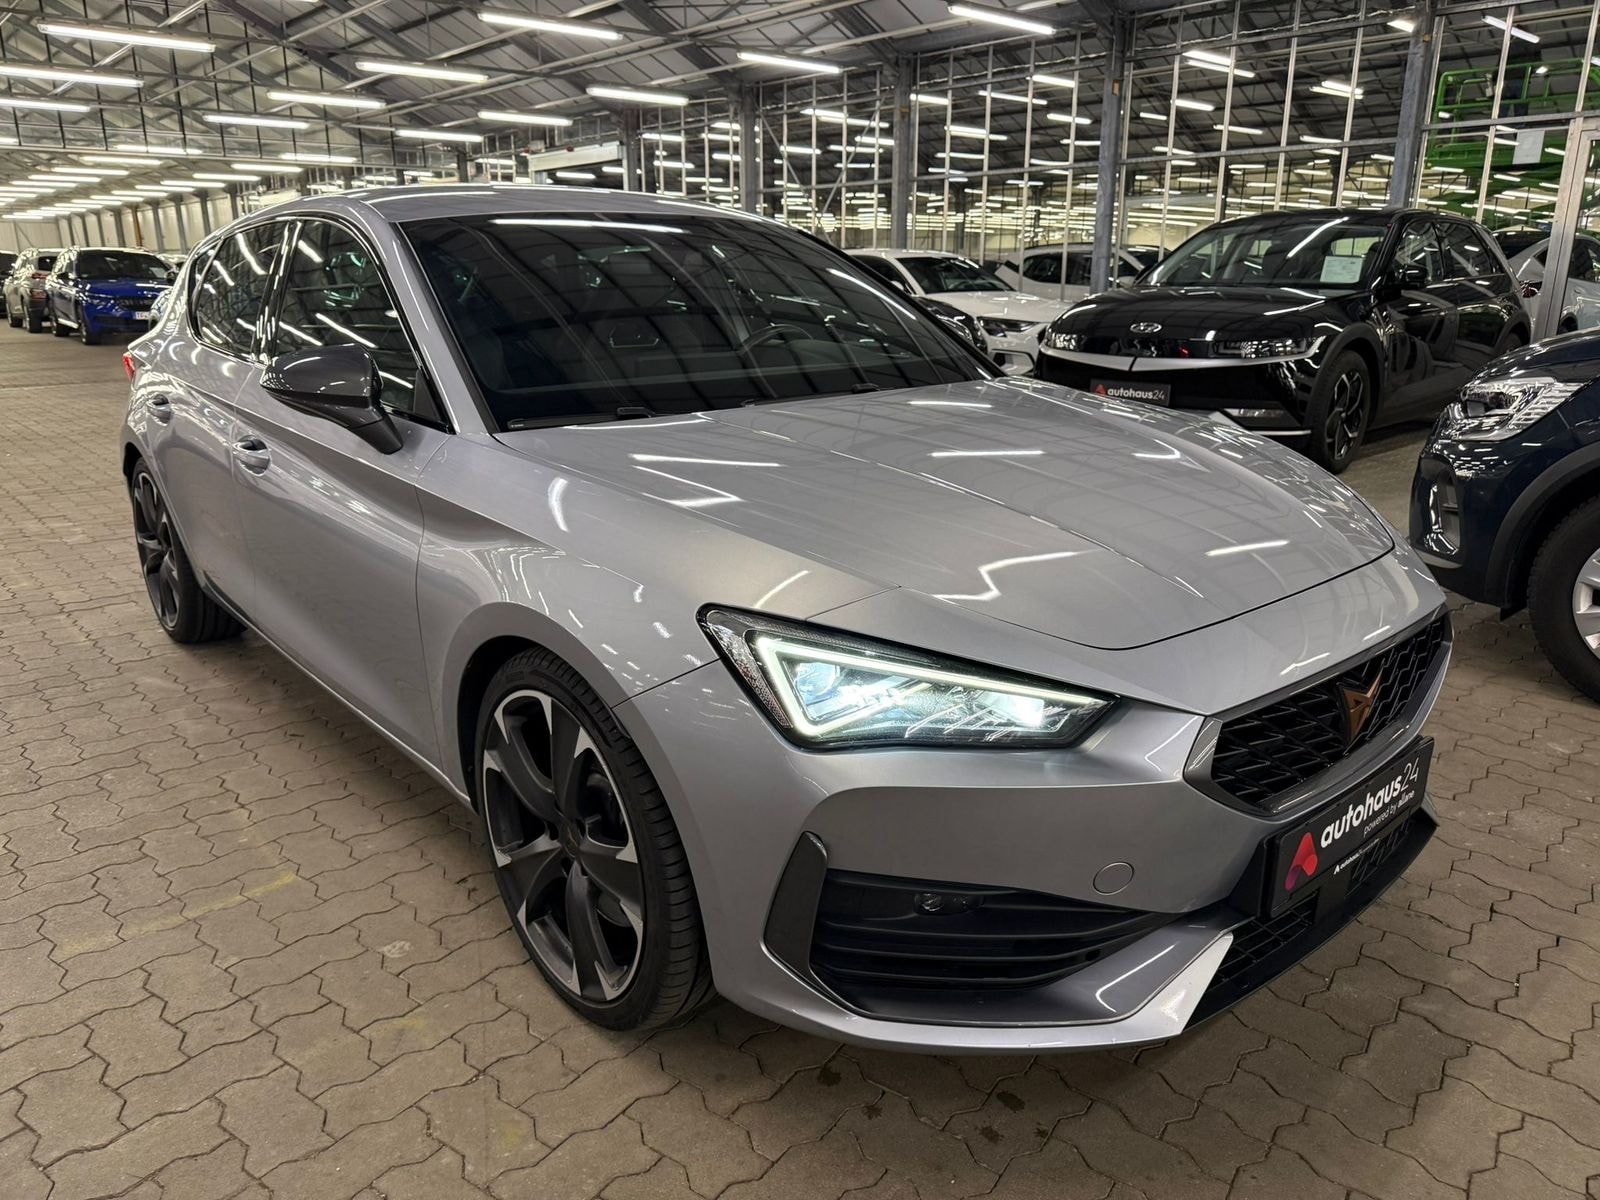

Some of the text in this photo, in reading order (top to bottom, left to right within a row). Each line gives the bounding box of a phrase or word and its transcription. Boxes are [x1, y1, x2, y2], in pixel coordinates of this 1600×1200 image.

[1107, 387, 1165, 400] autohaus24
[1320, 757, 1420, 848] autohaus24
[1363, 805, 1390, 838] powered
[1389, 802, 1398, 815] by
